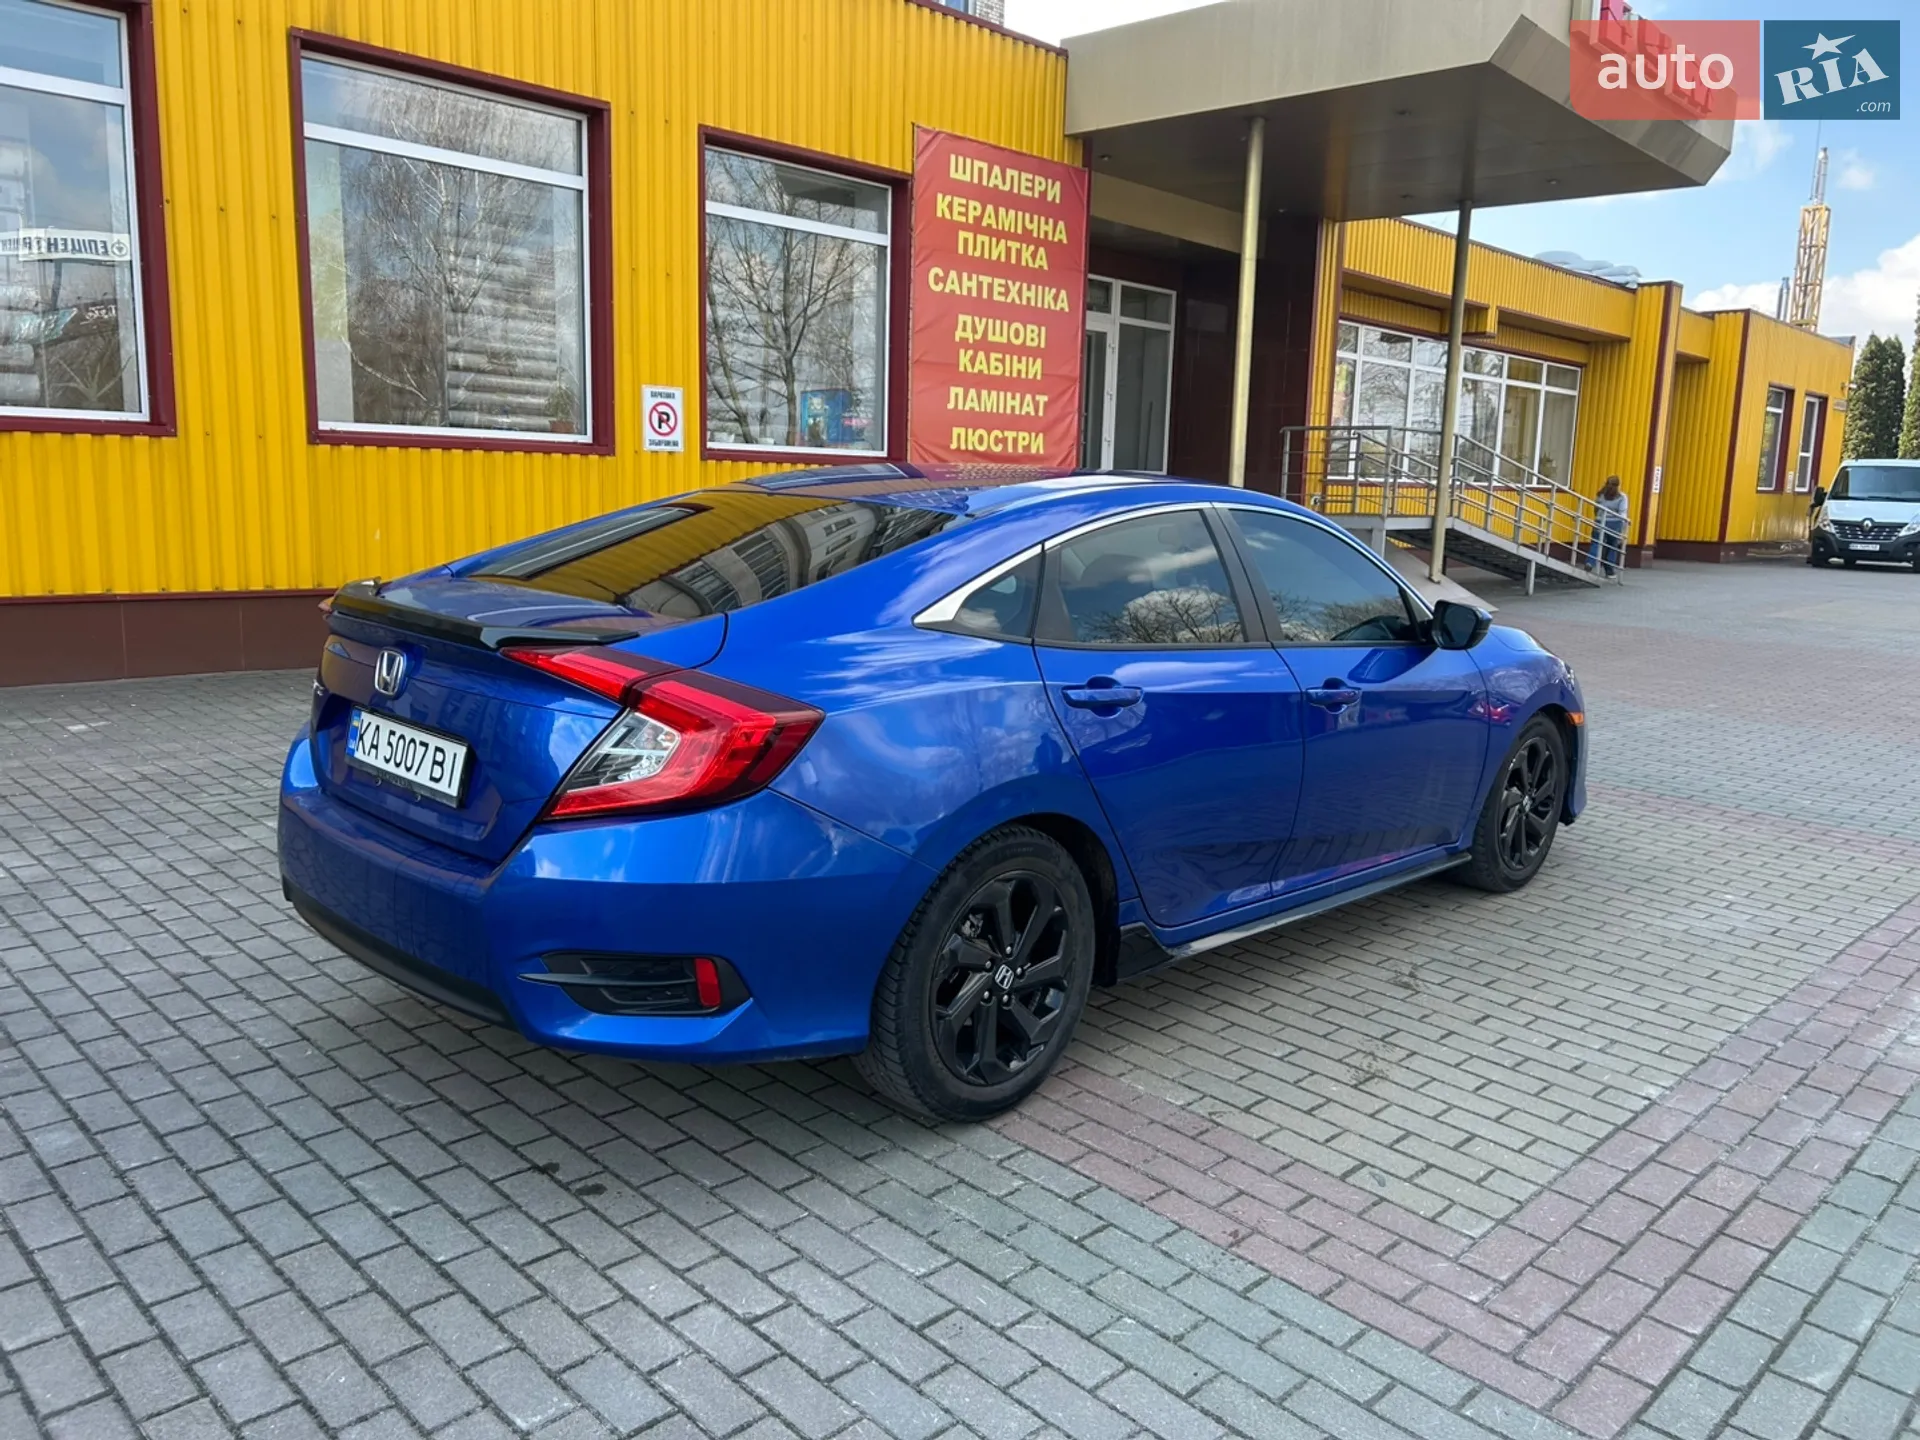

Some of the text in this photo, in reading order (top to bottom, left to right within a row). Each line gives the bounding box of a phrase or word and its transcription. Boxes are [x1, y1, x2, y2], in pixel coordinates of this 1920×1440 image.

[949, 154, 1061, 204] ШПАЛЕРИ
[936, 192, 1068, 244] КЕРАМІЧНА
[957, 230, 1048, 270] ПЛИТКА
[928, 266, 1069, 312] САНТЕХНІКА
[955, 313, 1046, 348] ДУШОВІ
[958, 348, 1042, 381] КАБІНИ
[947, 386, 1048, 417] ЛАМІНАТ
[950, 427, 1044, 454] ЛЮСТРИ
[356, 719, 457, 788] KA 5007 BI
